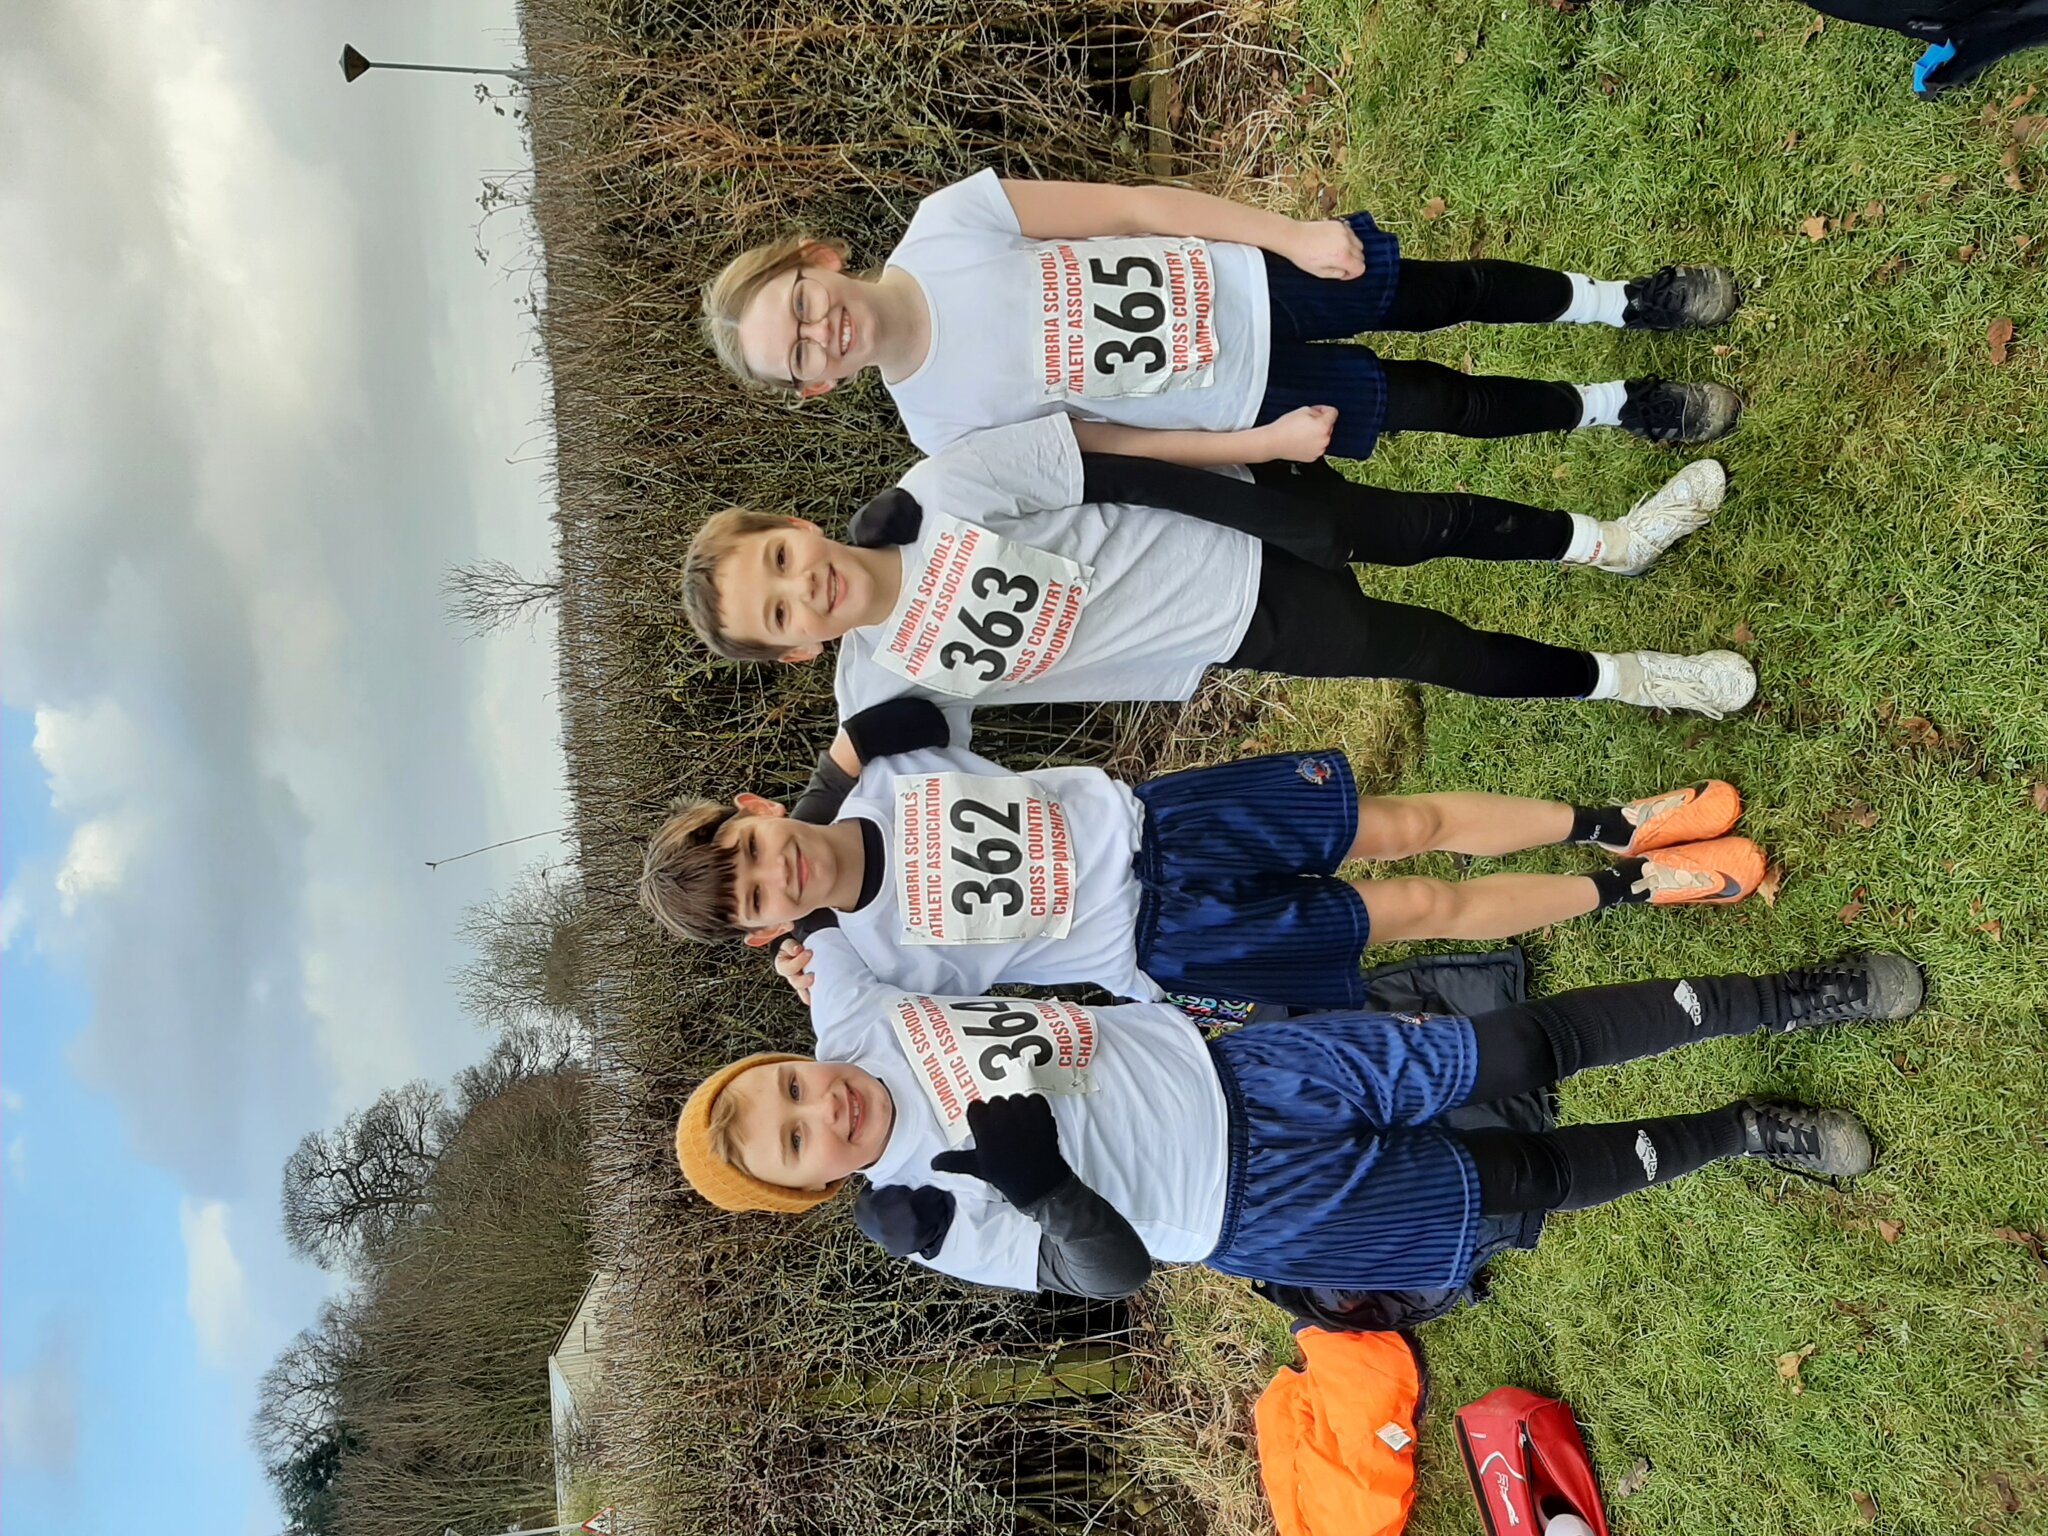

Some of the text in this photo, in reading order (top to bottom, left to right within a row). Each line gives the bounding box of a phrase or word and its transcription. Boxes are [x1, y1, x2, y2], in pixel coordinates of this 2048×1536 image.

[1038, 252, 1061, 384] CUMBRIA SCHOOLS
[1057, 245, 1084, 394] ATHLETIC ASSOCIATION
[1088, 256, 1166, 375] 365
[1164, 250, 1188, 372] CROSS COUNTRY
[1187, 248, 1212, 370] CHAMPIONSHIPS
[890, 532, 954, 654] CUMBRIA SCHOOLS
[905, 529, 980, 676] ATHLETIC ASSOCIATION
[940, 567, 1039, 682] 363
[1027, 579, 1064, 646] COUNTRY
[904, 792, 922, 926] CUMBRIA SCHOOLS
[926, 778, 944, 938] ATHLETIC ASSOCIATION
[950, 798, 1024, 917] 362
[1026, 796, 1046, 916] CROSS COUNTRY
[1047, 800, 1069, 915] CHAMPIONSHIPS
[897, 1002, 962, 1120] CUMBRIA SCHOOLS
[948, 1056, 983, 1102] HLETIC
[949, 1000, 1053, 1081] 364
[1048, 1020, 1074, 1068] CROSS
